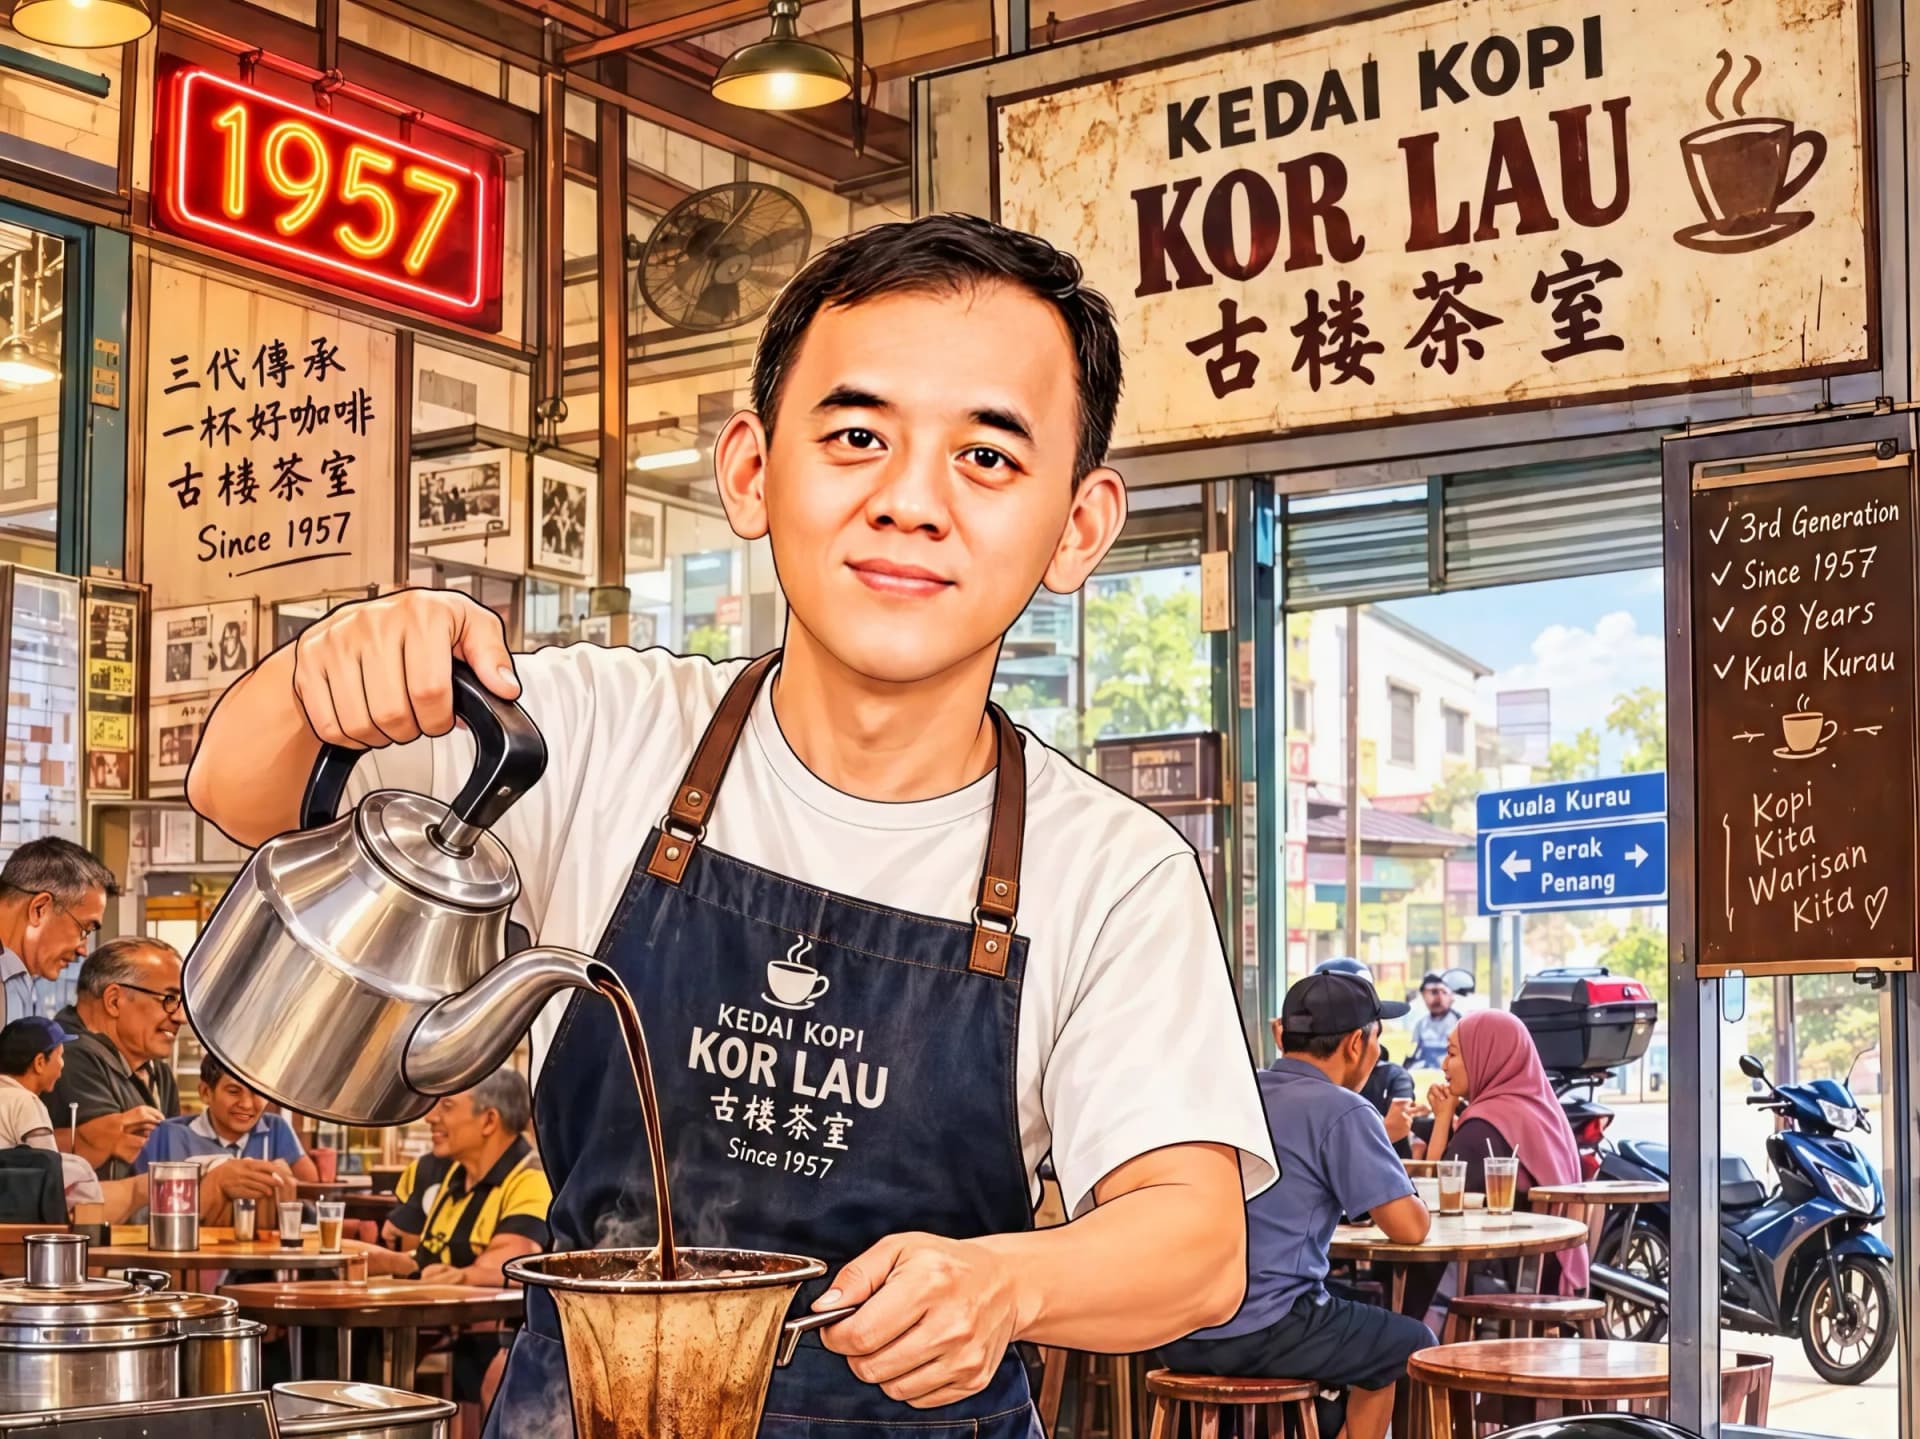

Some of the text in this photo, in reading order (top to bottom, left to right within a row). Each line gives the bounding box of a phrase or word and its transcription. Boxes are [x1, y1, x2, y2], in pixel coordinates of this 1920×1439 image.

[1167, 15, 1603, 160] KEDAI KOPI
[214, 105, 458, 276] 1957
[1130, 96, 1631, 298] KOR LAU
[1186, 249, 1625, 399] 古楼茶室
[164, 336, 346, 395] 三代傳承
[162, 387, 375, 448] 一杯好咖啡
[168, 449, 356, 510] 古楼茶室
[198, 511, 351, 562] Since 1957
[1740, 500, 1899, 543] 3rd Generation
[1742, 546, 1878, 590] Since 1957
[1751, 599, 1874, 638] 68 Years
[1744, 647, 1895, 690] Kuala Kurau
[1498, 789, 1630, 820] Kuala Kurau
[1752, 781, 1813, 828] Kopi
[1542, 836, 1603, 862] Perak
[1755, 822, 1816, 866] Kita
[1541, 873, 1615, 895] Penang
[1748, 843, 1867, 905] Warisan
[1793, 886, 1854, 932] Kita
[718, 1003, 864, 1052] KEDAI KOPI
[688, 1026, 889, 1109] KOR LAU
[711, 1087, 853, 1150] 古楼茶室
[728, 1137, 834, 1179] Since 1957
